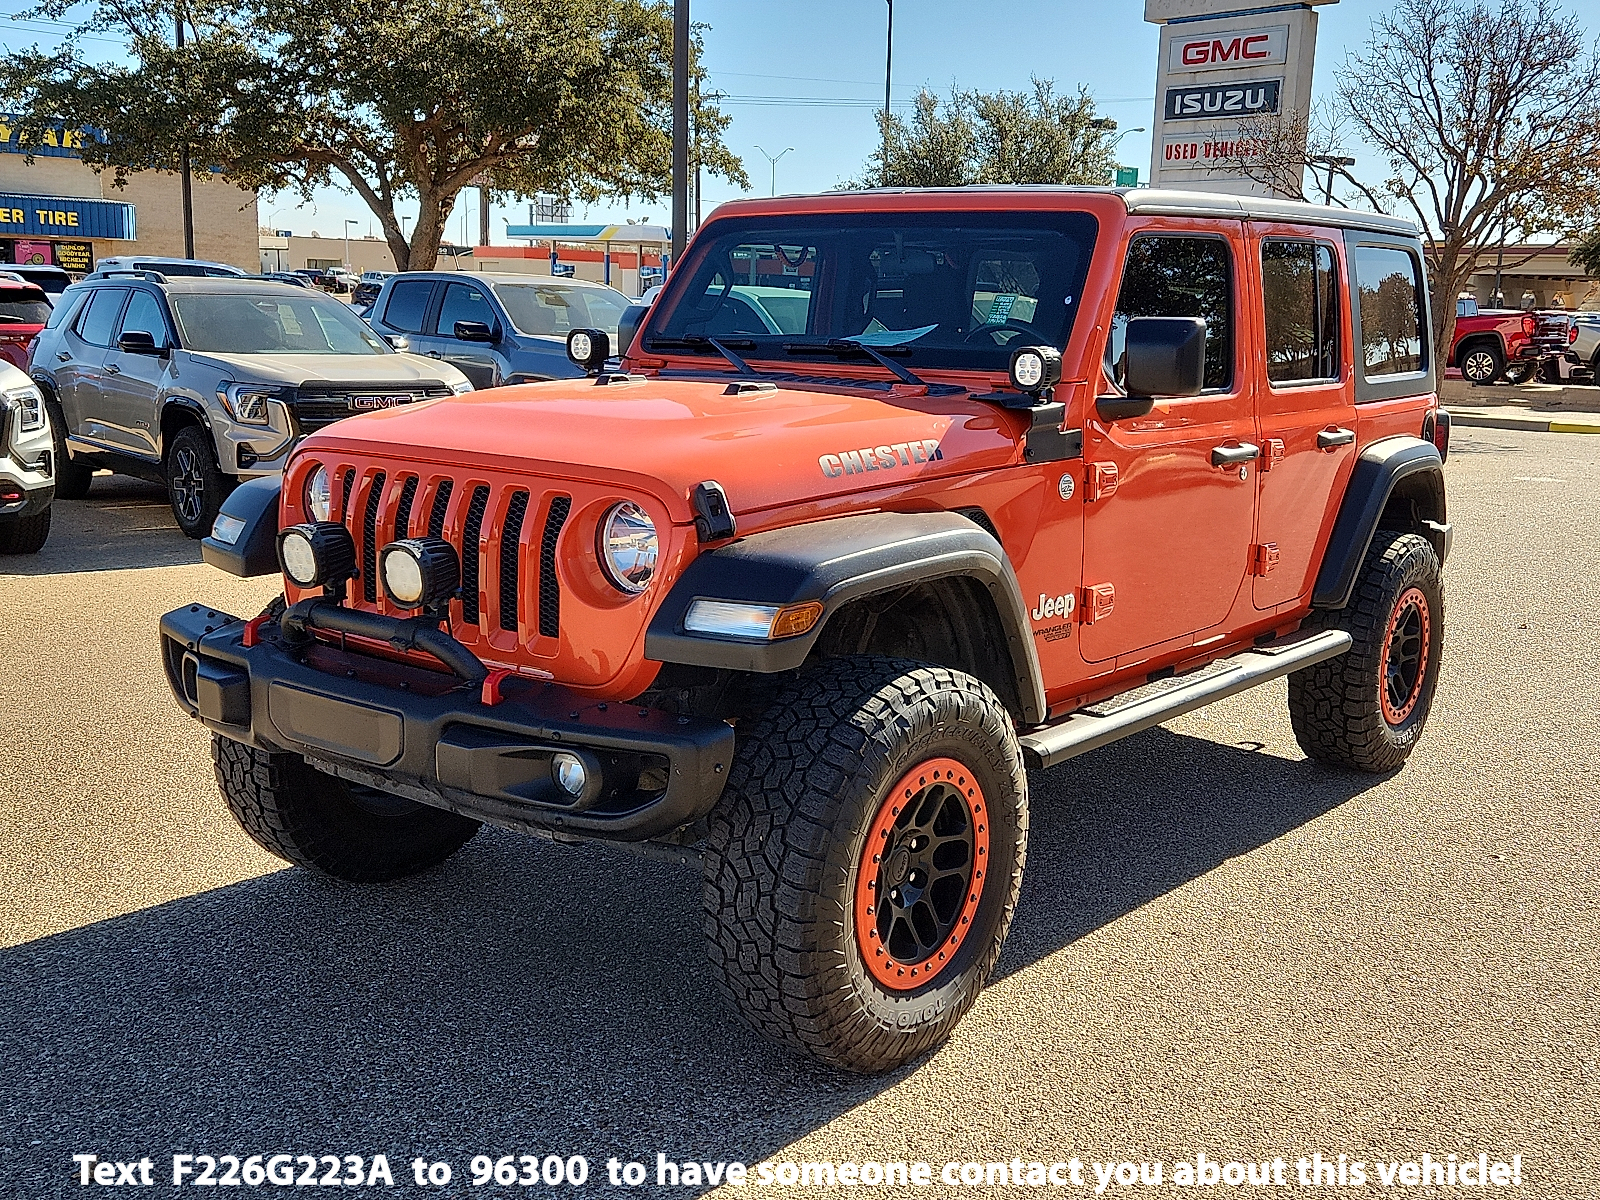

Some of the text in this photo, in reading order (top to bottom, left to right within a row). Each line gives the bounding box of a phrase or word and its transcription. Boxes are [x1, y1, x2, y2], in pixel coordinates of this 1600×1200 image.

[1182, 34, 1269, 66] GMC
[1174, 88, 1265, 115] ISUZU
[1165, 143, 1198, 161] USED
[36, 209, 79, 227] TIRE
[354, 396, 411, 409] GMC
[818, 438, 944, 478] CHESTER
[1032, 593, 1075, 620] Jeep
[1033, 622, 1072, 636] WRANGLER
[897, 995, 947, 1028] TOYO
